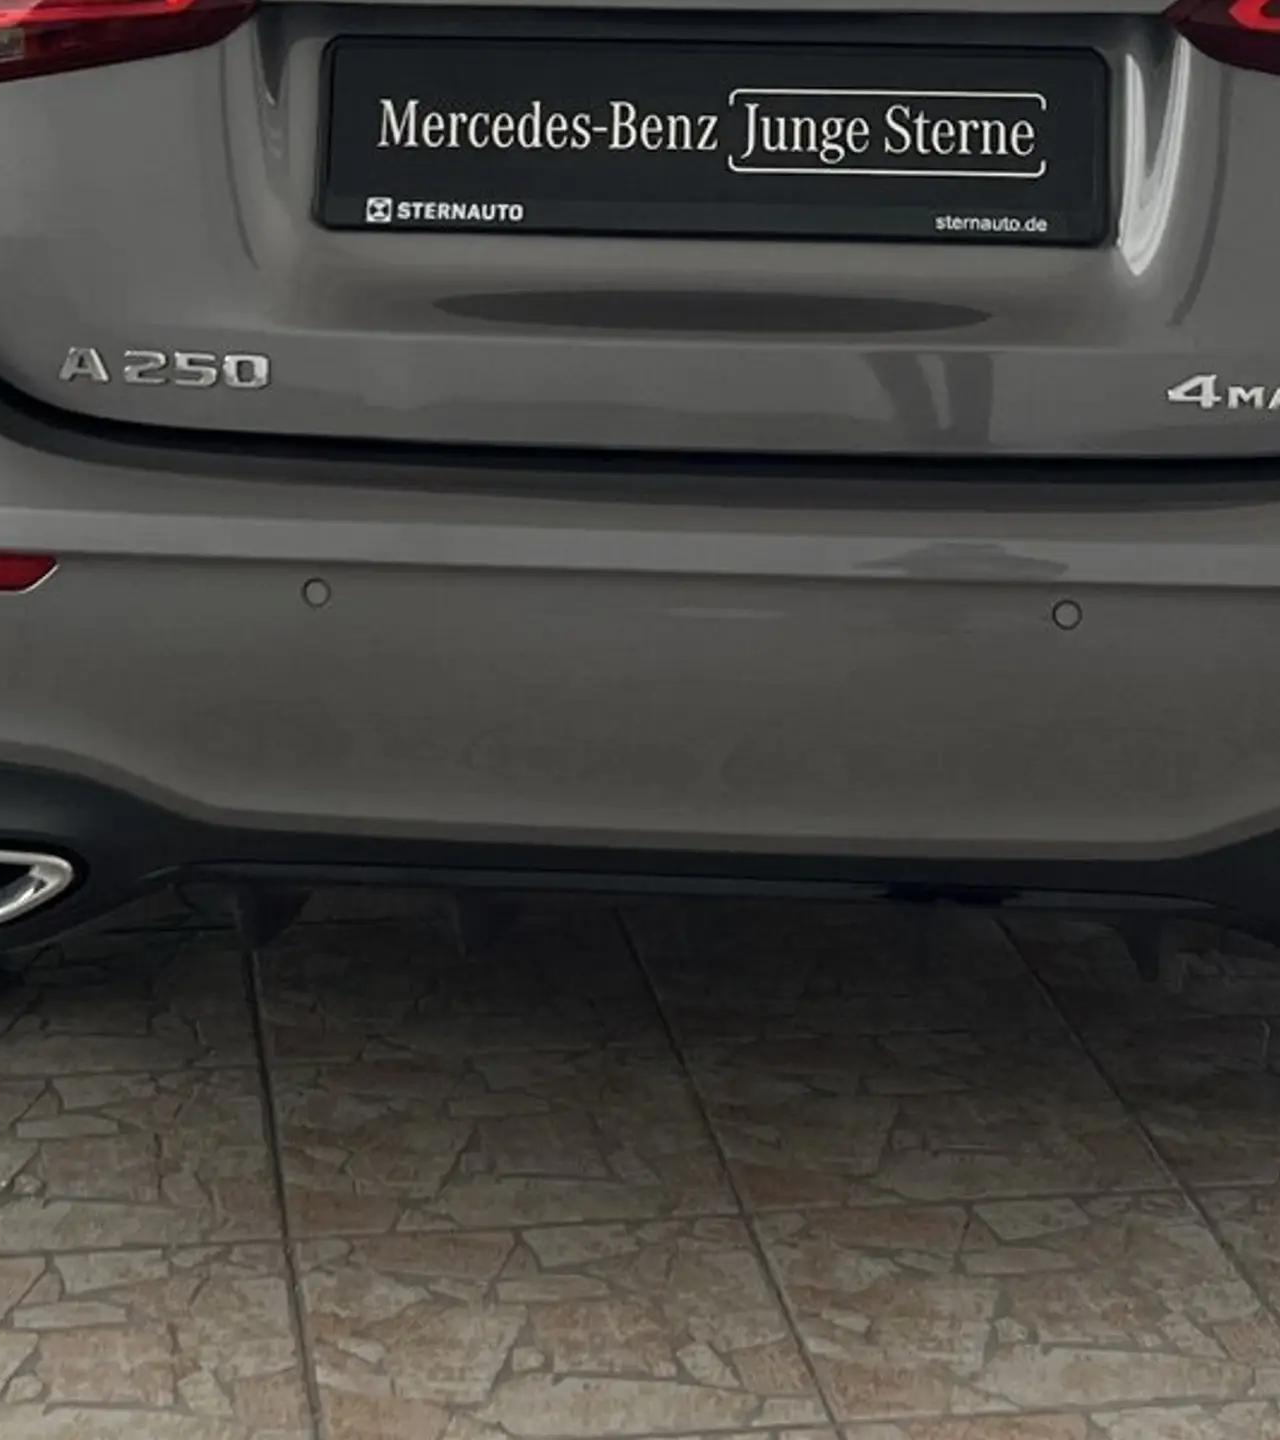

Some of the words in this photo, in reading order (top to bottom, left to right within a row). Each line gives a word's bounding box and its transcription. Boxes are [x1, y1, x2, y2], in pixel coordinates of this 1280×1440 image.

[377, 99, 718, 150] Mercedes-Benz
[740, 103, 869, 164] Junge
[884, 104, 1035, 156] Sterne
[397, 201, 524, 222] STERNAUTO
[935, 215, 1048, 232] sternauto.de
[59, 347, 109, 382] A
[124, 350, 269, 388] 250
